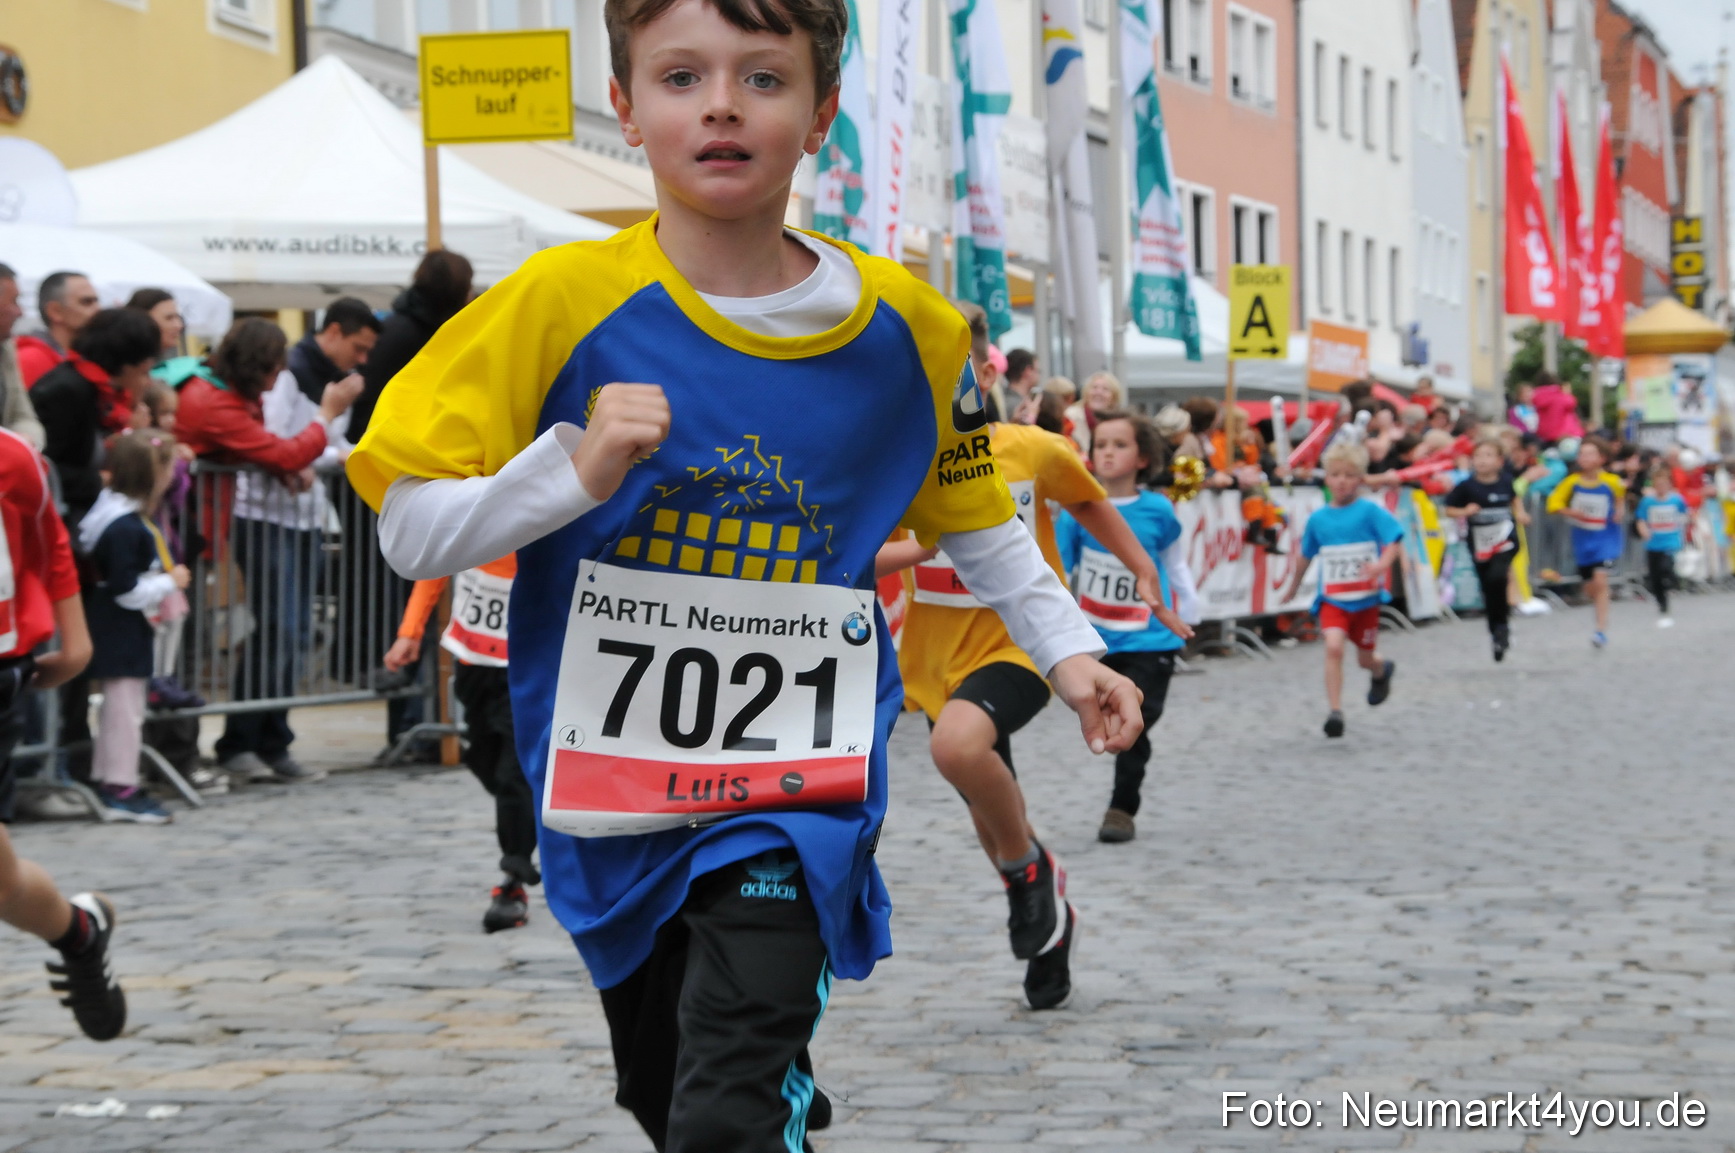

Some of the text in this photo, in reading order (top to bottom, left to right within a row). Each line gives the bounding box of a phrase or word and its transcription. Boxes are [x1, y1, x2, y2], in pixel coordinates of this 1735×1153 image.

[431, 64, 561, 88] Schnupper-
[475, 92, 517, 115] lauf
[1235, 268, 1282, 286] Block
[1242, 295, 1274, 338] A
[937, 434, 993, 469] PAR
[937, 462, 995, 487] Neum
[462, 584, 504, 630] 758
[578, 590, 829, 639] PARTL Neumarkt
[597, 637, 838, 752] 7021
[565, 728, 577, 746] 4
[846, 744, 859, 753] K
[666, 772, 750, 802] Luis
[740, 880, 797, 901] adidas
